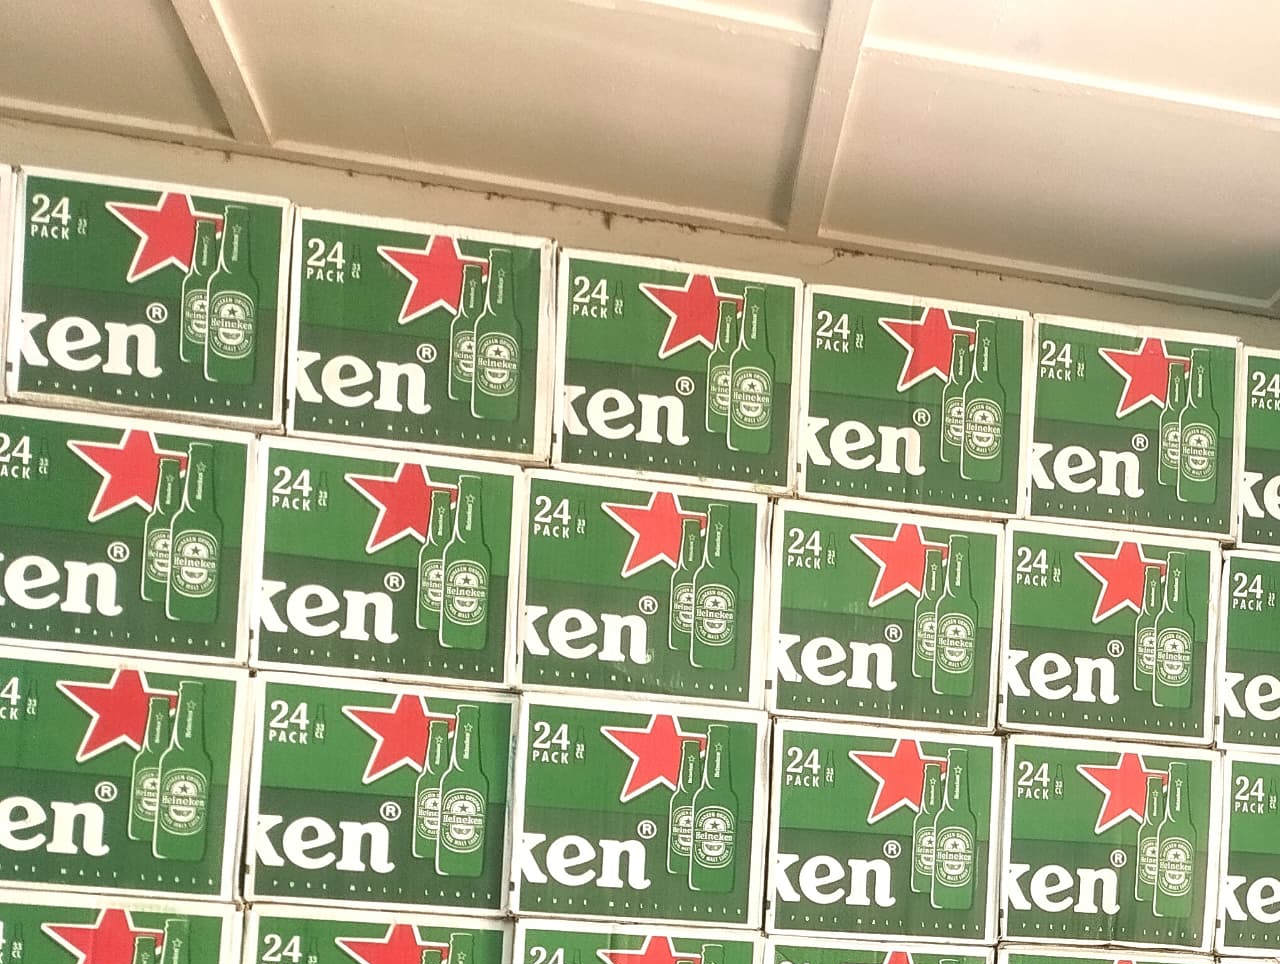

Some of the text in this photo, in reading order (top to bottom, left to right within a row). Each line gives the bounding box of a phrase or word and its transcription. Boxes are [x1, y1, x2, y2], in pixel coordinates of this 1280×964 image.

[31, 194, 71, 225] 24
[31, 225, 69, 240] PACK
[307, 238, 345, 269] 24
[307, 267, 344, 283] PACK
[573, 276, 609, 305] 24
[573, 304, 607, 318] PACK
[817, 311, 850, 339] 24
[1041, 340, 1072, 368] 24
[1041, 367, 1071, 381] PACK
[1252, 372, 1280, 398] 24
[273, 466, 312, 497] 24
[272, 495, 310, 511] PACK
[534, 496, 571, 525] 24
[534, 523, 569, 538] PACK
[788, 528, 822, 556] 24
[788, 555, 820, 569] PACK
[1017, 547, 1048, 574] 24
[1017, 573, 1047, 587] PACK
[1233, 573, 1263, 599] 24
[270, 700, 309, 730] 24
[269, 729, 307, 744] PACK
[533, 722, 570, 750] 24
[533, 750, 568, 764] PACK
[1018, 761, 1050, 787] 24
[1018, 787, 1048, 800] PACK
[262, 934, 302, 962] 24
